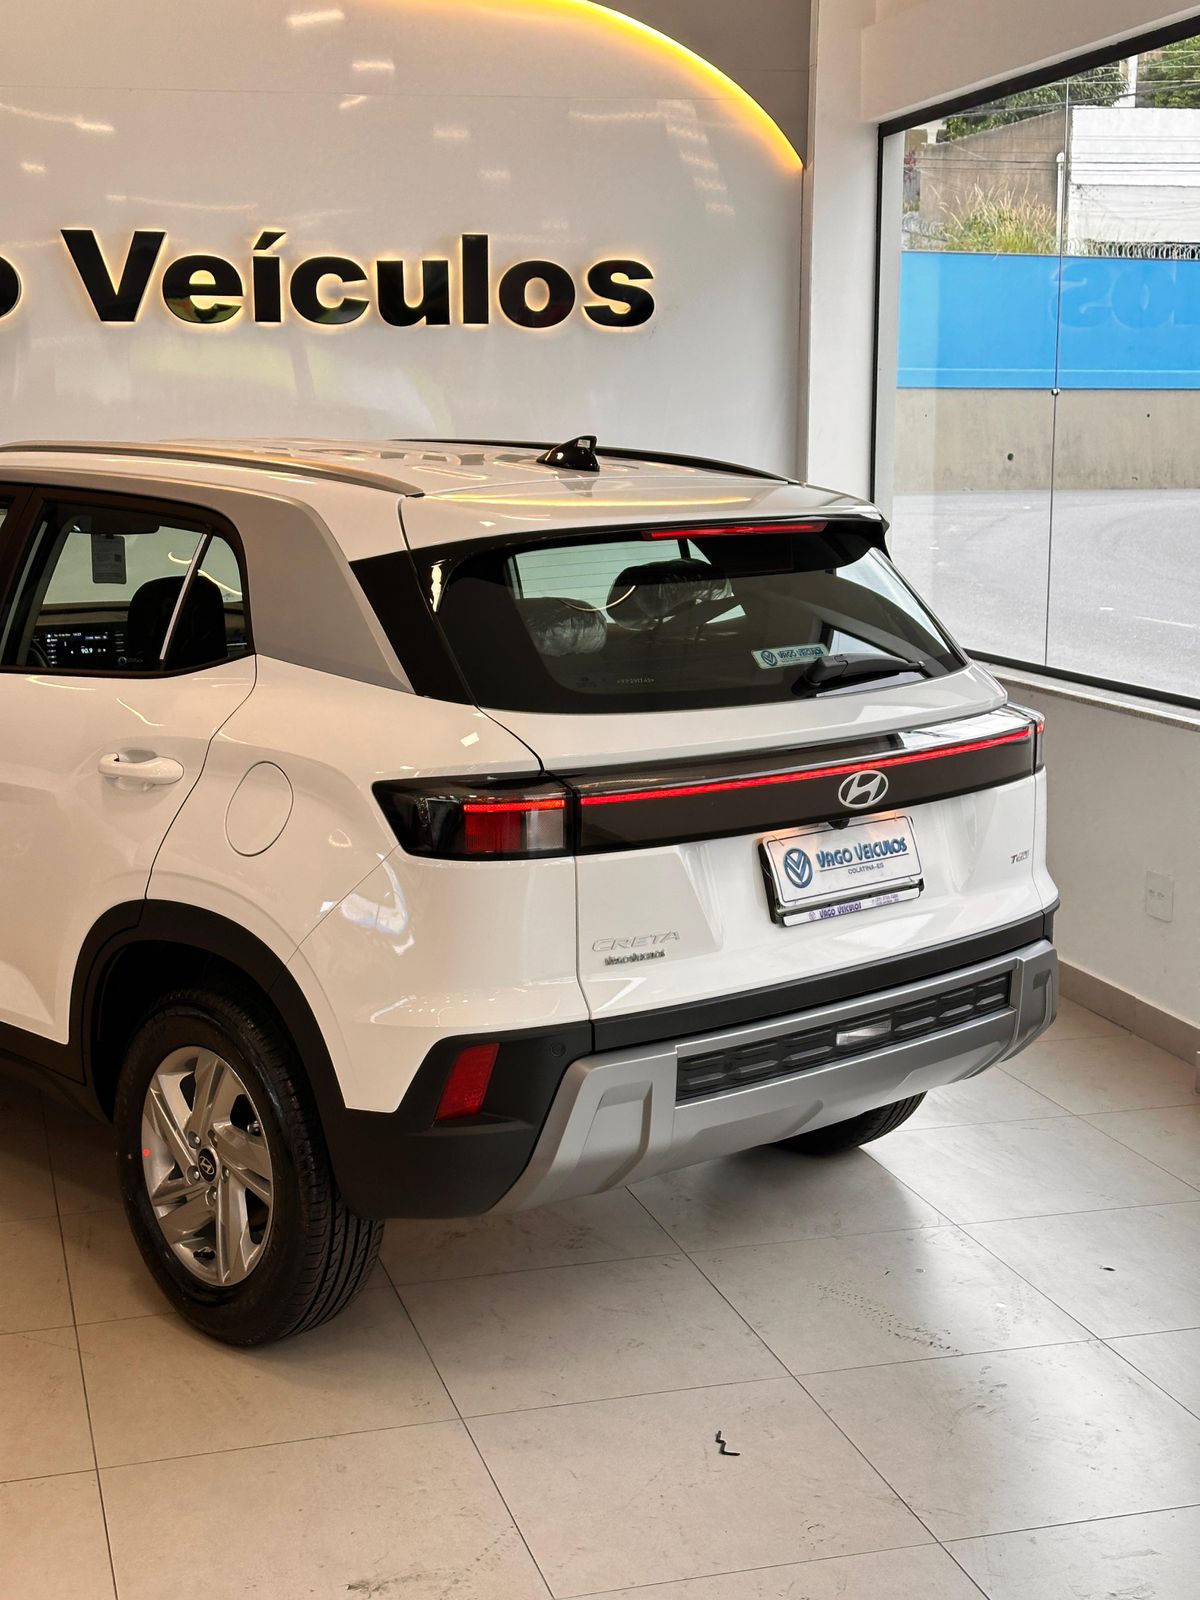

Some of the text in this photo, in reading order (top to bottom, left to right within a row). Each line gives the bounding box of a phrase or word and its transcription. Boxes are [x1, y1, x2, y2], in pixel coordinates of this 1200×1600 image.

[60, 228, 655, 328] Veículos
[816, 848, 853, 868] VAGO
[592, 931, 680, 952] CRETA
